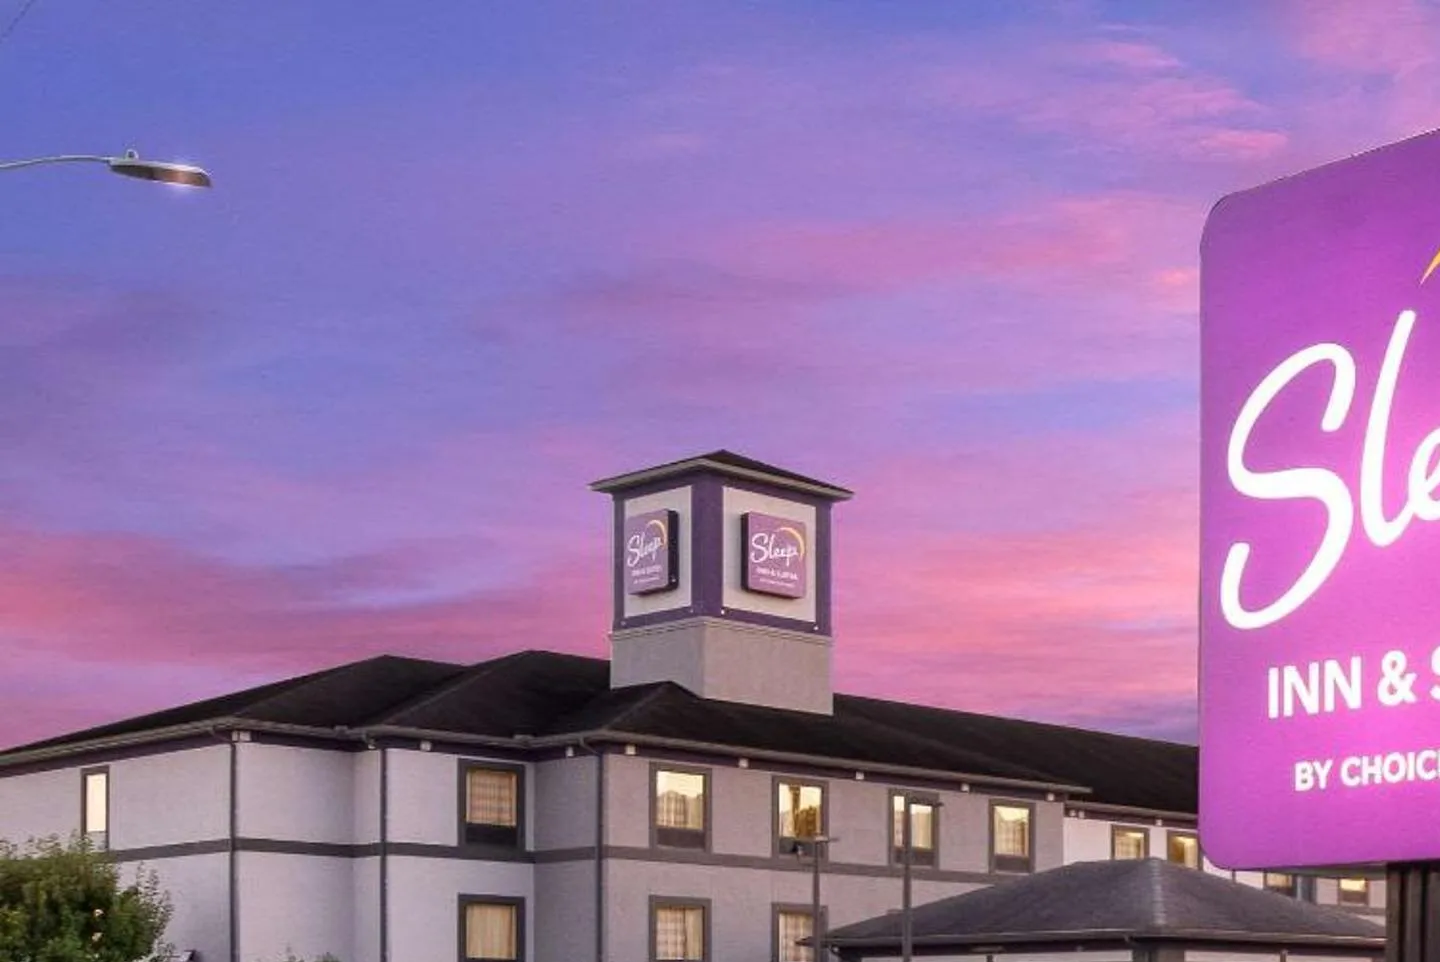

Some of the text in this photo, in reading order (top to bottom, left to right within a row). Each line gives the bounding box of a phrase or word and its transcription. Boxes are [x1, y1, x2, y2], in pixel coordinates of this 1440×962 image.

[627, 531, 664, 567] Sleep
[751, 532, 798, 567] Sleep
[1267, 657, 1362, 719] INN
[1377, 650, 1417, 706] &
[1295, 759, 1333, 791] BY
